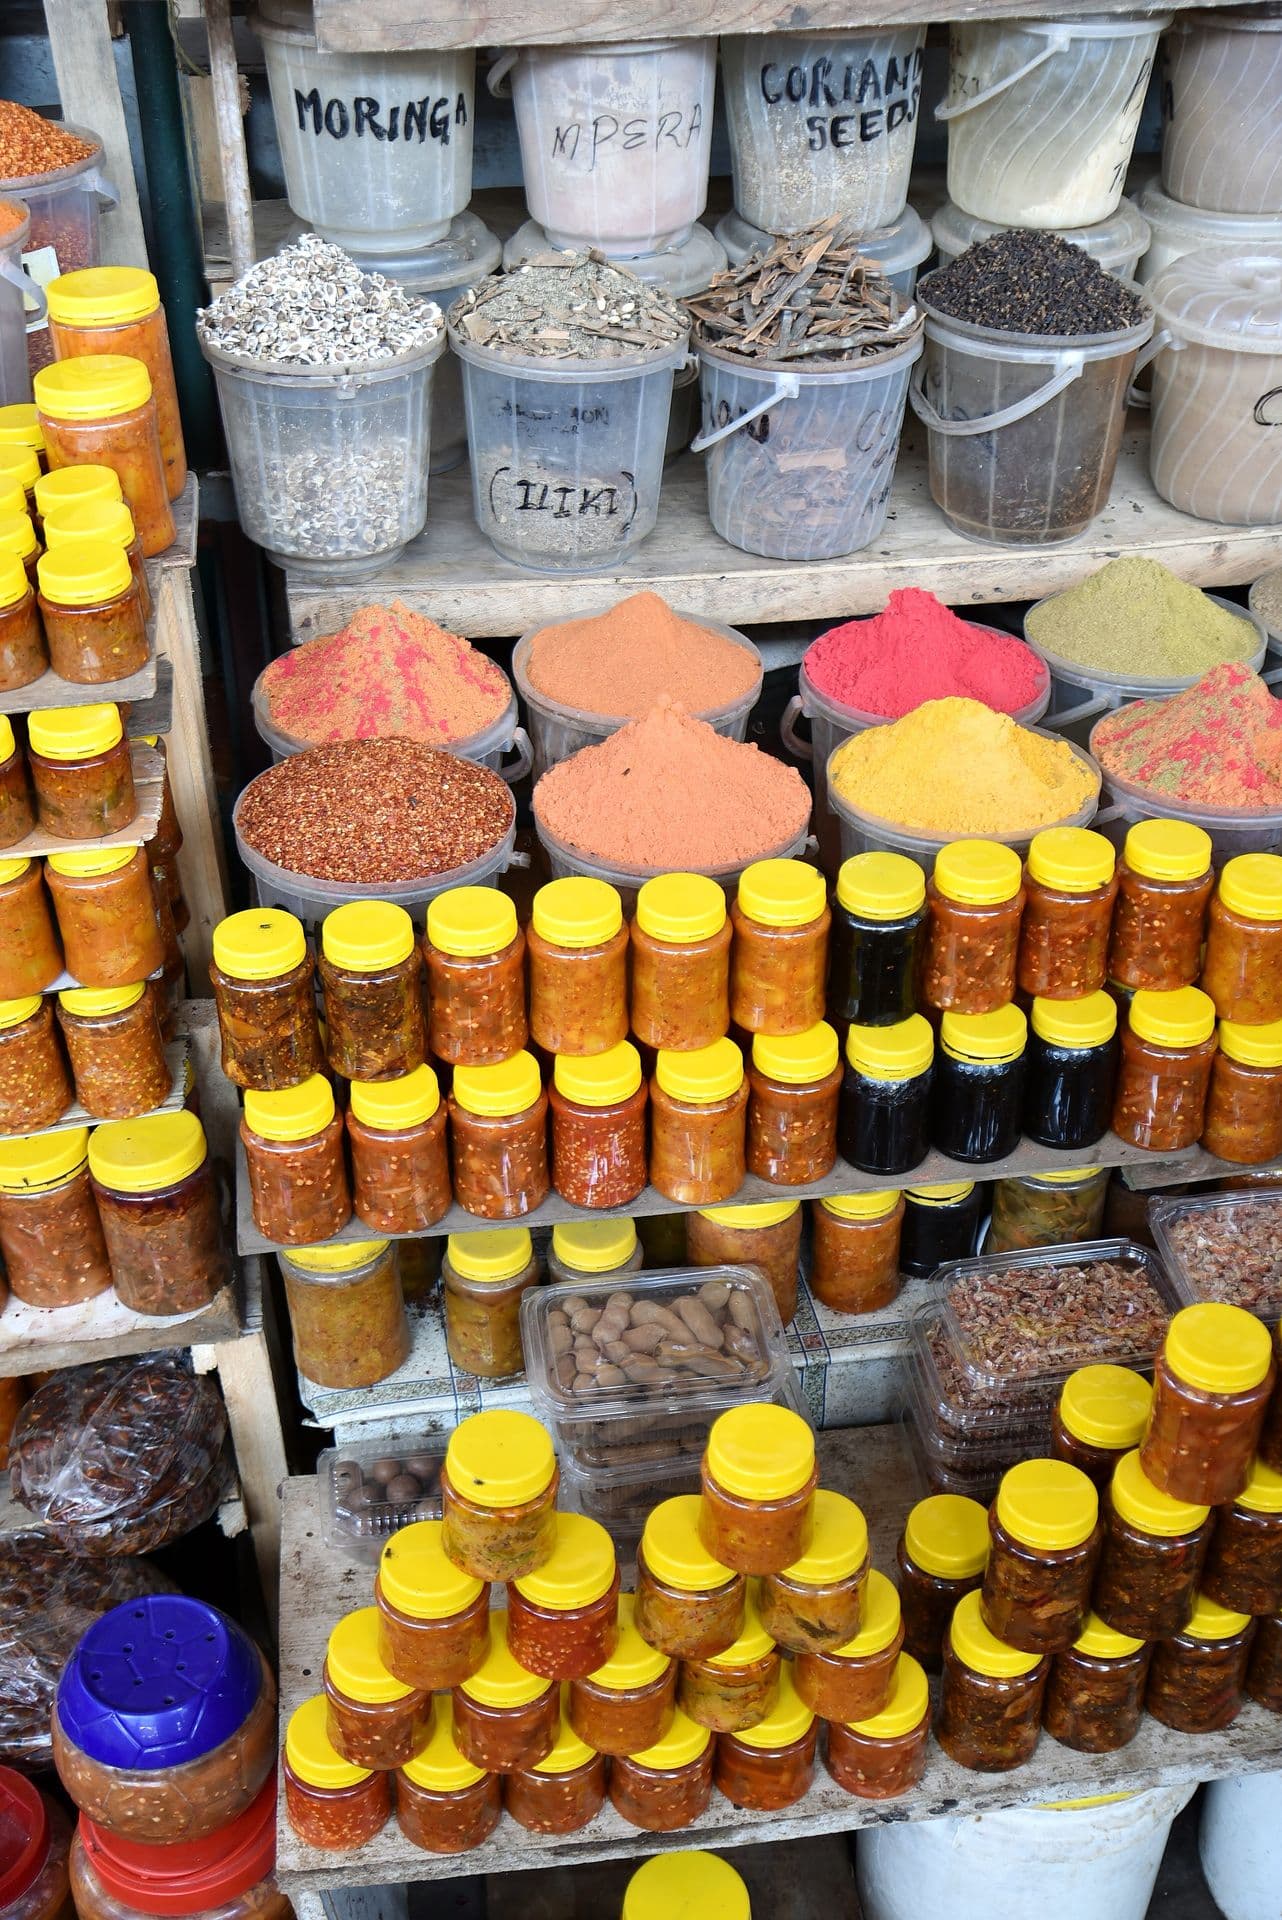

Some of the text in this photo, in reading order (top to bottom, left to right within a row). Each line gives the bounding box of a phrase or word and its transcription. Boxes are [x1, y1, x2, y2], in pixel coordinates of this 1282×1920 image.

[295, 87, 467, 146] MORINGA
[552, 104, 702, 172] MPERA
[807, 85, 921, 151] SEEDS
